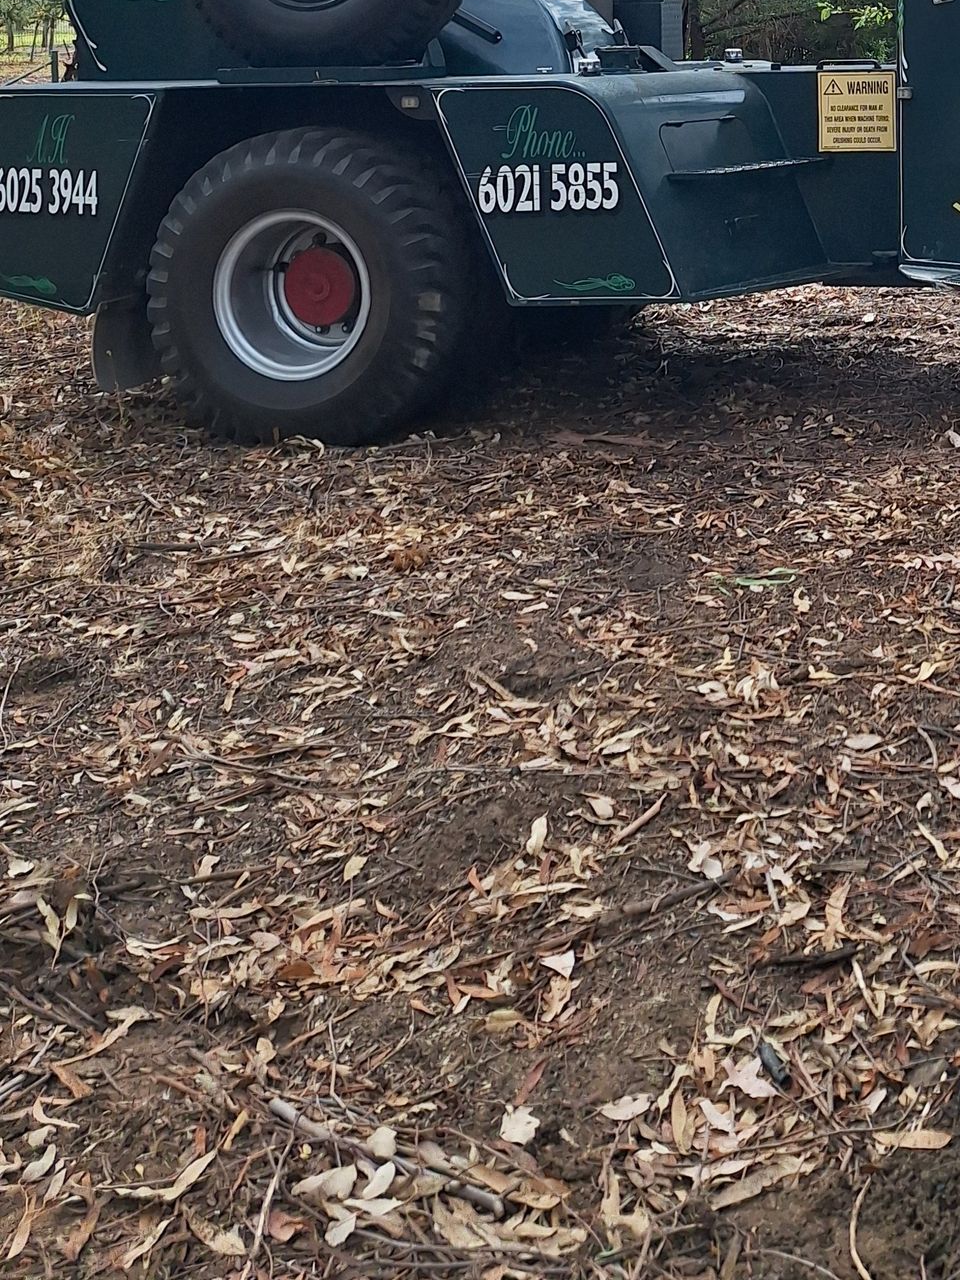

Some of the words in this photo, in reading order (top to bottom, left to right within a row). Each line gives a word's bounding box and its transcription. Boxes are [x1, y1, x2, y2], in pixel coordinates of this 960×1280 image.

[846, 80, 889, 95] WARNING
[48, 168, 98, 216] 3944
[478, 164, 541, 214] 6021
[550, 162, 619, 211] 5855
